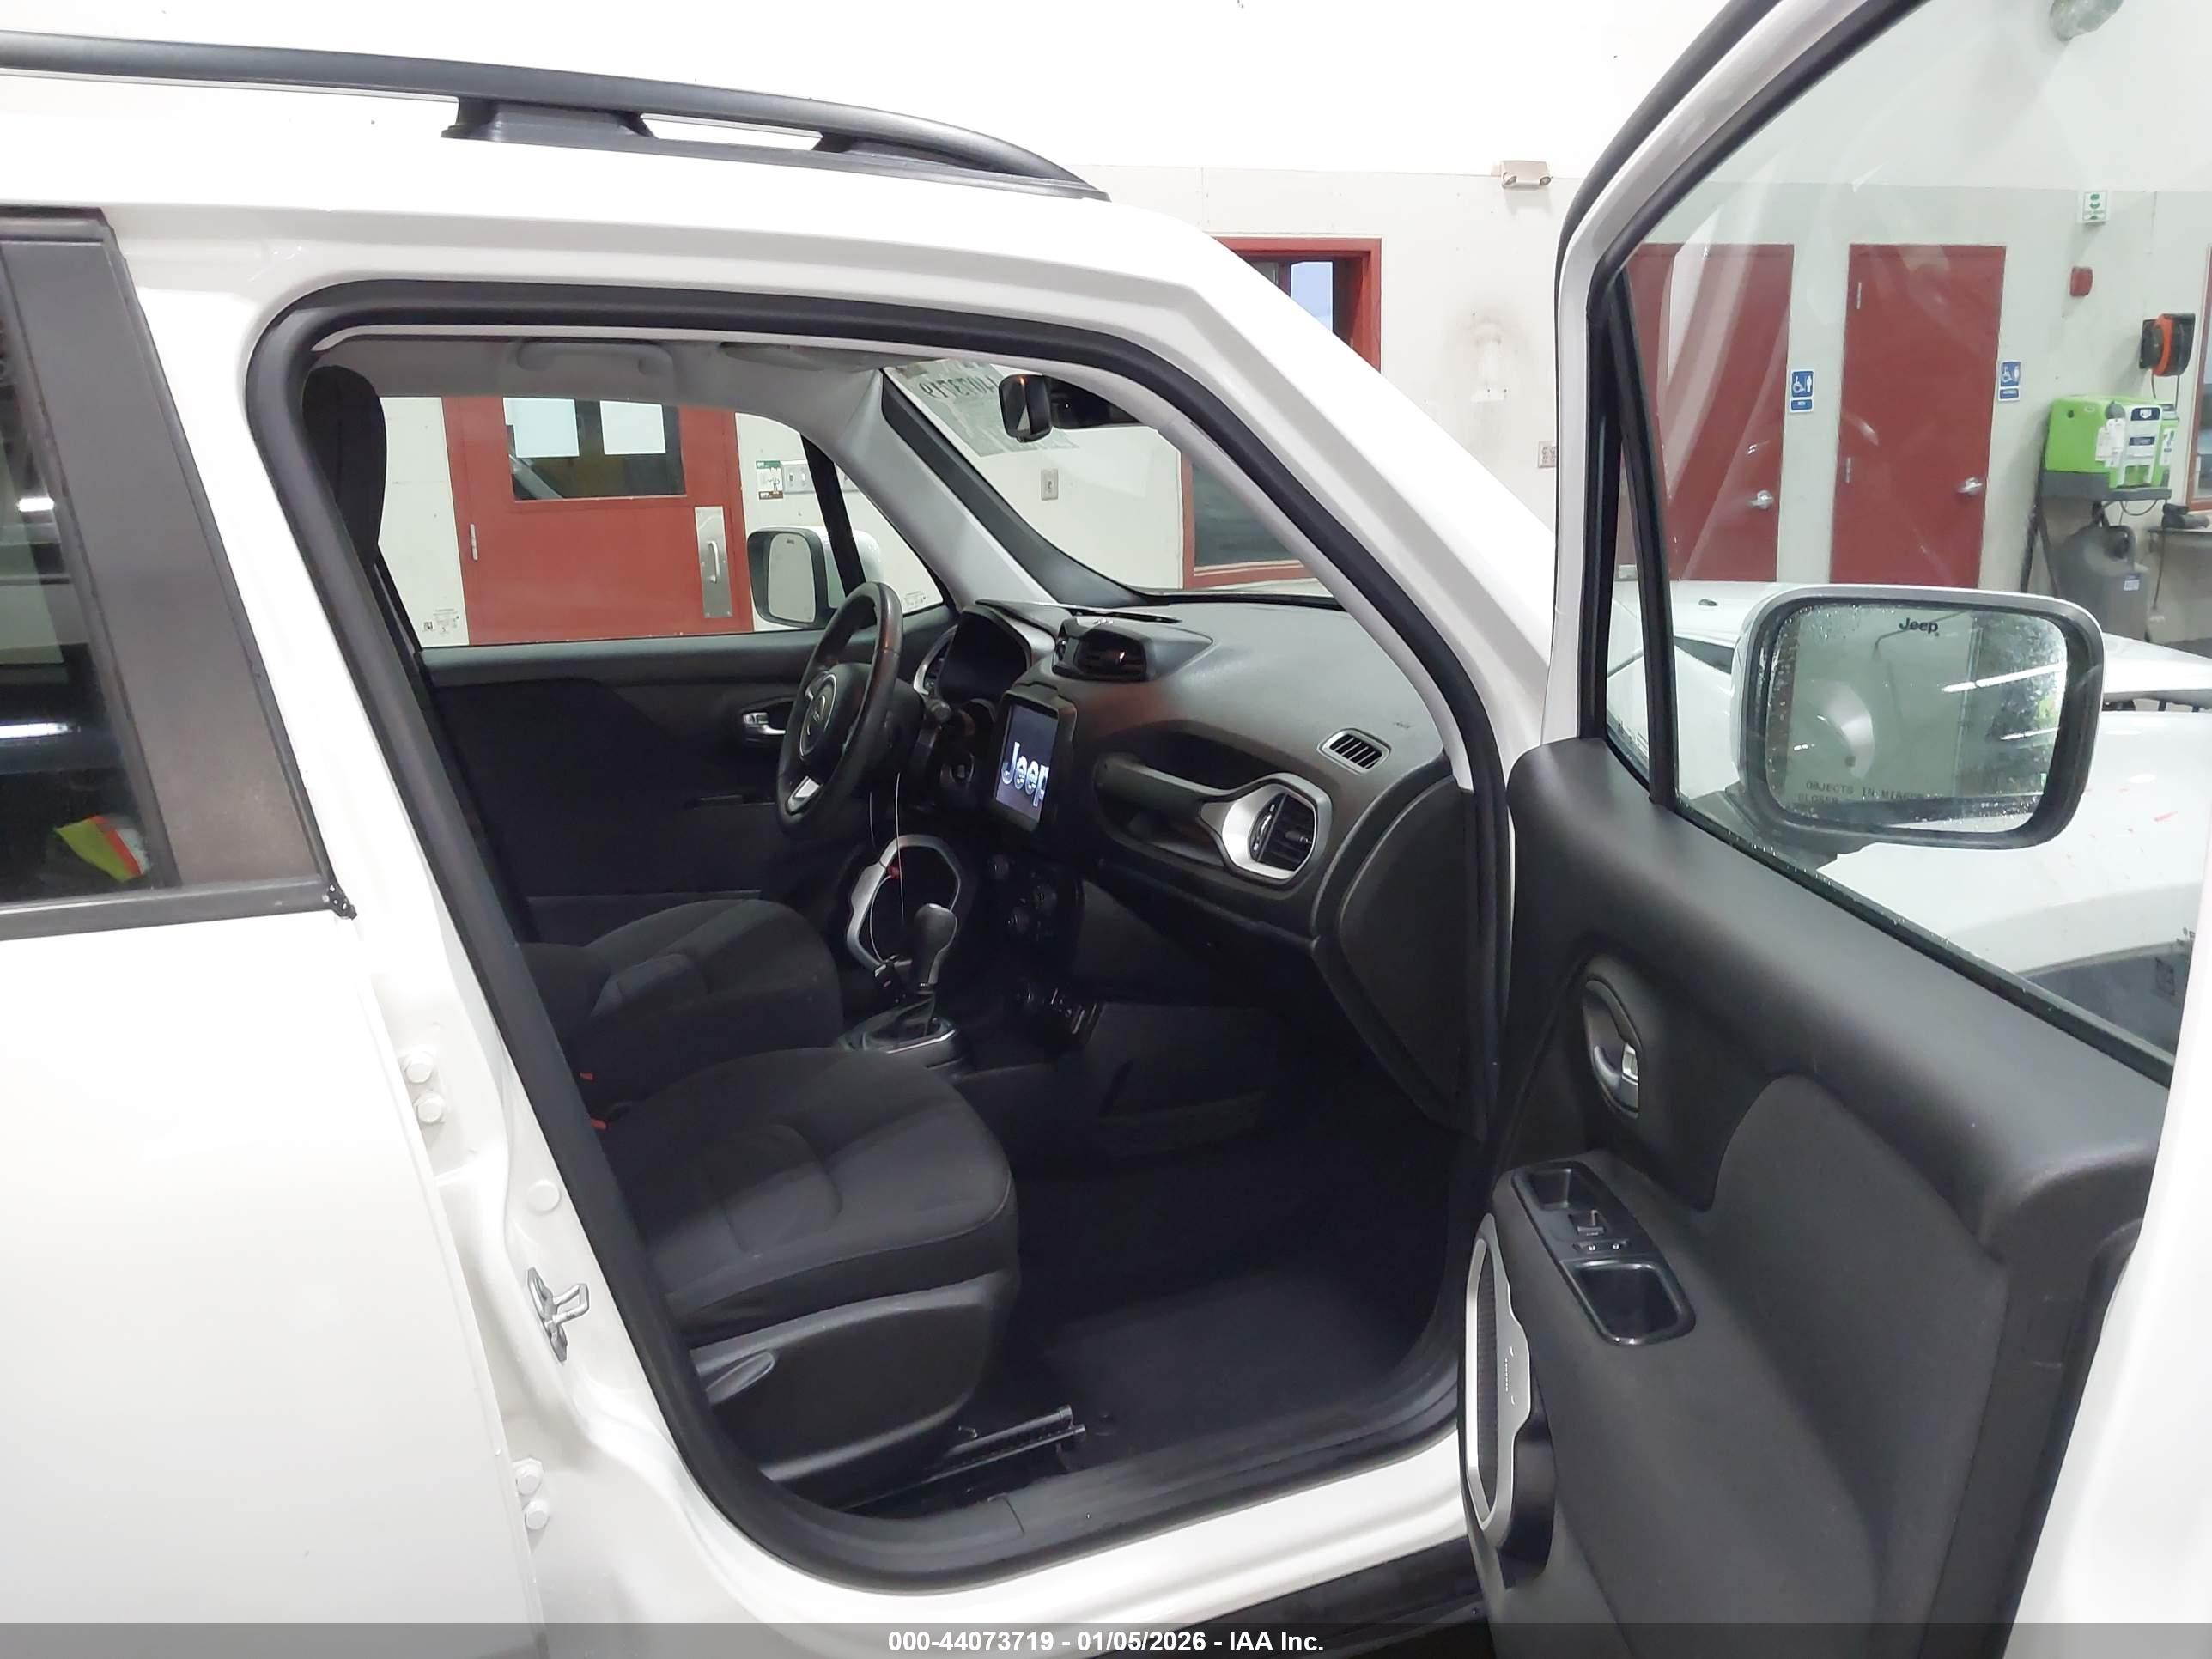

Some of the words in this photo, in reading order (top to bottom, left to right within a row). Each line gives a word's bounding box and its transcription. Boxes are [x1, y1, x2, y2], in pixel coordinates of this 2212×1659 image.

[1899, 617, 1939, 635] Jeep
[1001, 741, 1049, 807] Jeep
[1806, 781, 1854, 795] OBJECTS
